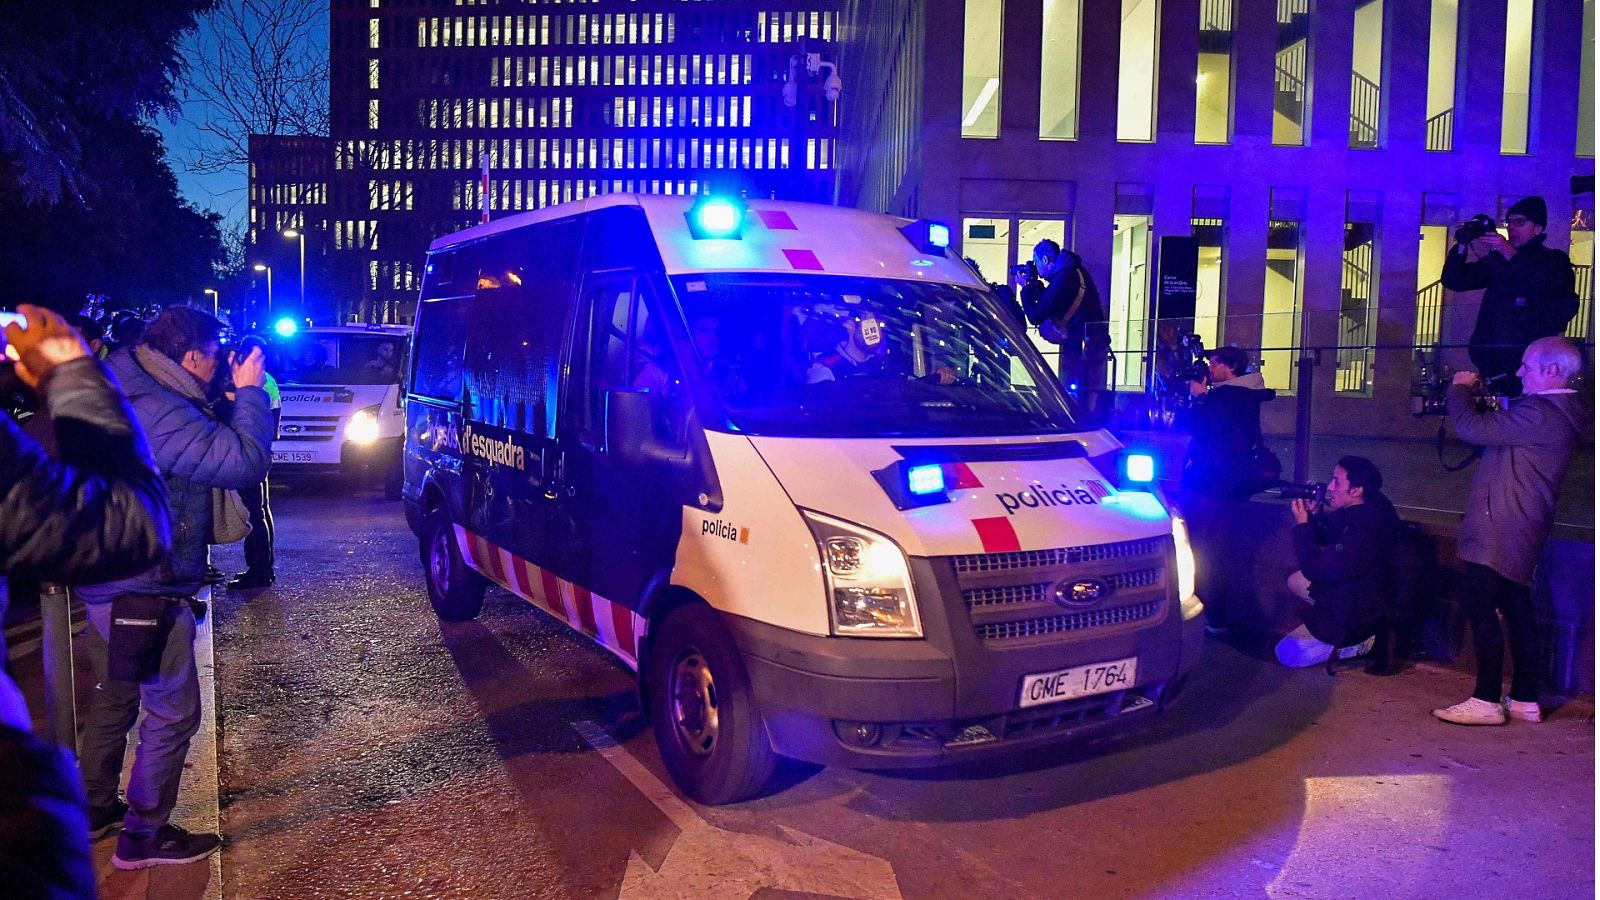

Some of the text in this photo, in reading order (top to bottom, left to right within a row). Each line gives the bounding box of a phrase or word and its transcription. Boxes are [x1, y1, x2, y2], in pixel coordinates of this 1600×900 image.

[281, 394, 320, 403] policia
[272, 452, 312, 461] CME 1539
[462, 424, 525, 471] d'esquadra
[995, 484, 1098, 515] policia
[702, 519, 737, 541] policia
[1030, 663, 1127, 701] CME 1764
